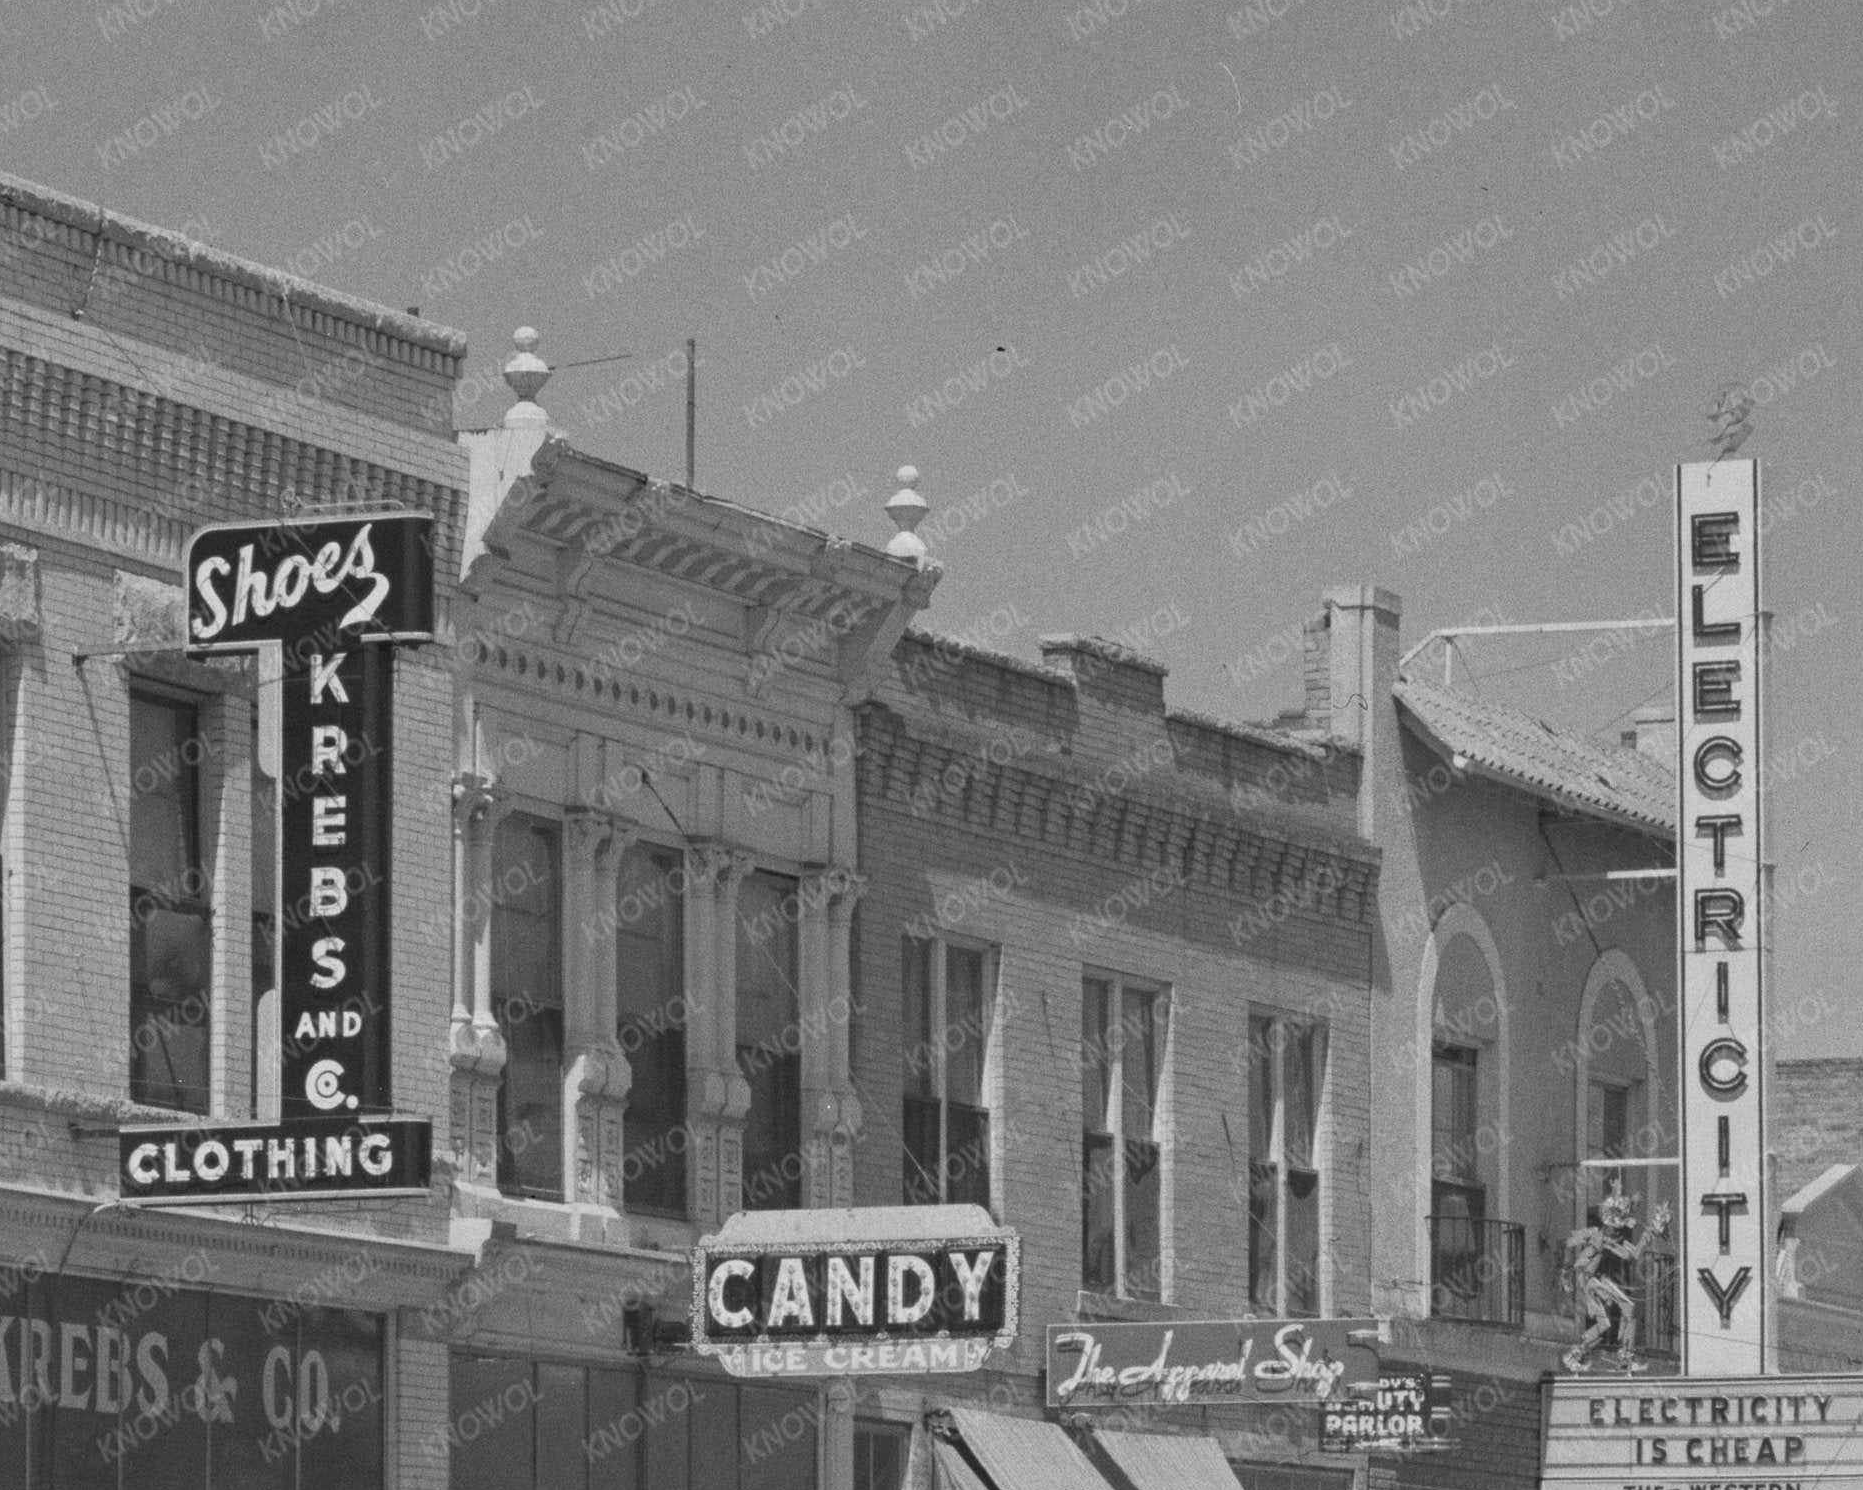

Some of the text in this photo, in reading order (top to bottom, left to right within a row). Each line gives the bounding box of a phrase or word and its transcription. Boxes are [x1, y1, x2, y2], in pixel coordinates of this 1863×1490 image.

[190, 522, 390, 639] Shoes
[309, 652, 350, 991] KREBS
[1689, 513, 1750, 1329] ELECTRICITY
[295, 1010, 362, 1041] AND
[127, 1132, 394, 1187] CLOTHING
[707, 1251, 994, 1329] CANDY
[193, 1337, 238, 1424] &
[751, 1344, 958, 1372] ICE CREAM
[1055, 1324, 1344, 1402] The Apparel Shop
[1324, 1414, 1425, 1437] PARLOR
[1588, 1394, 1832, 1427] ELECTRICITY
[1637, 1435, 1805, 1465] IS CHEAP
